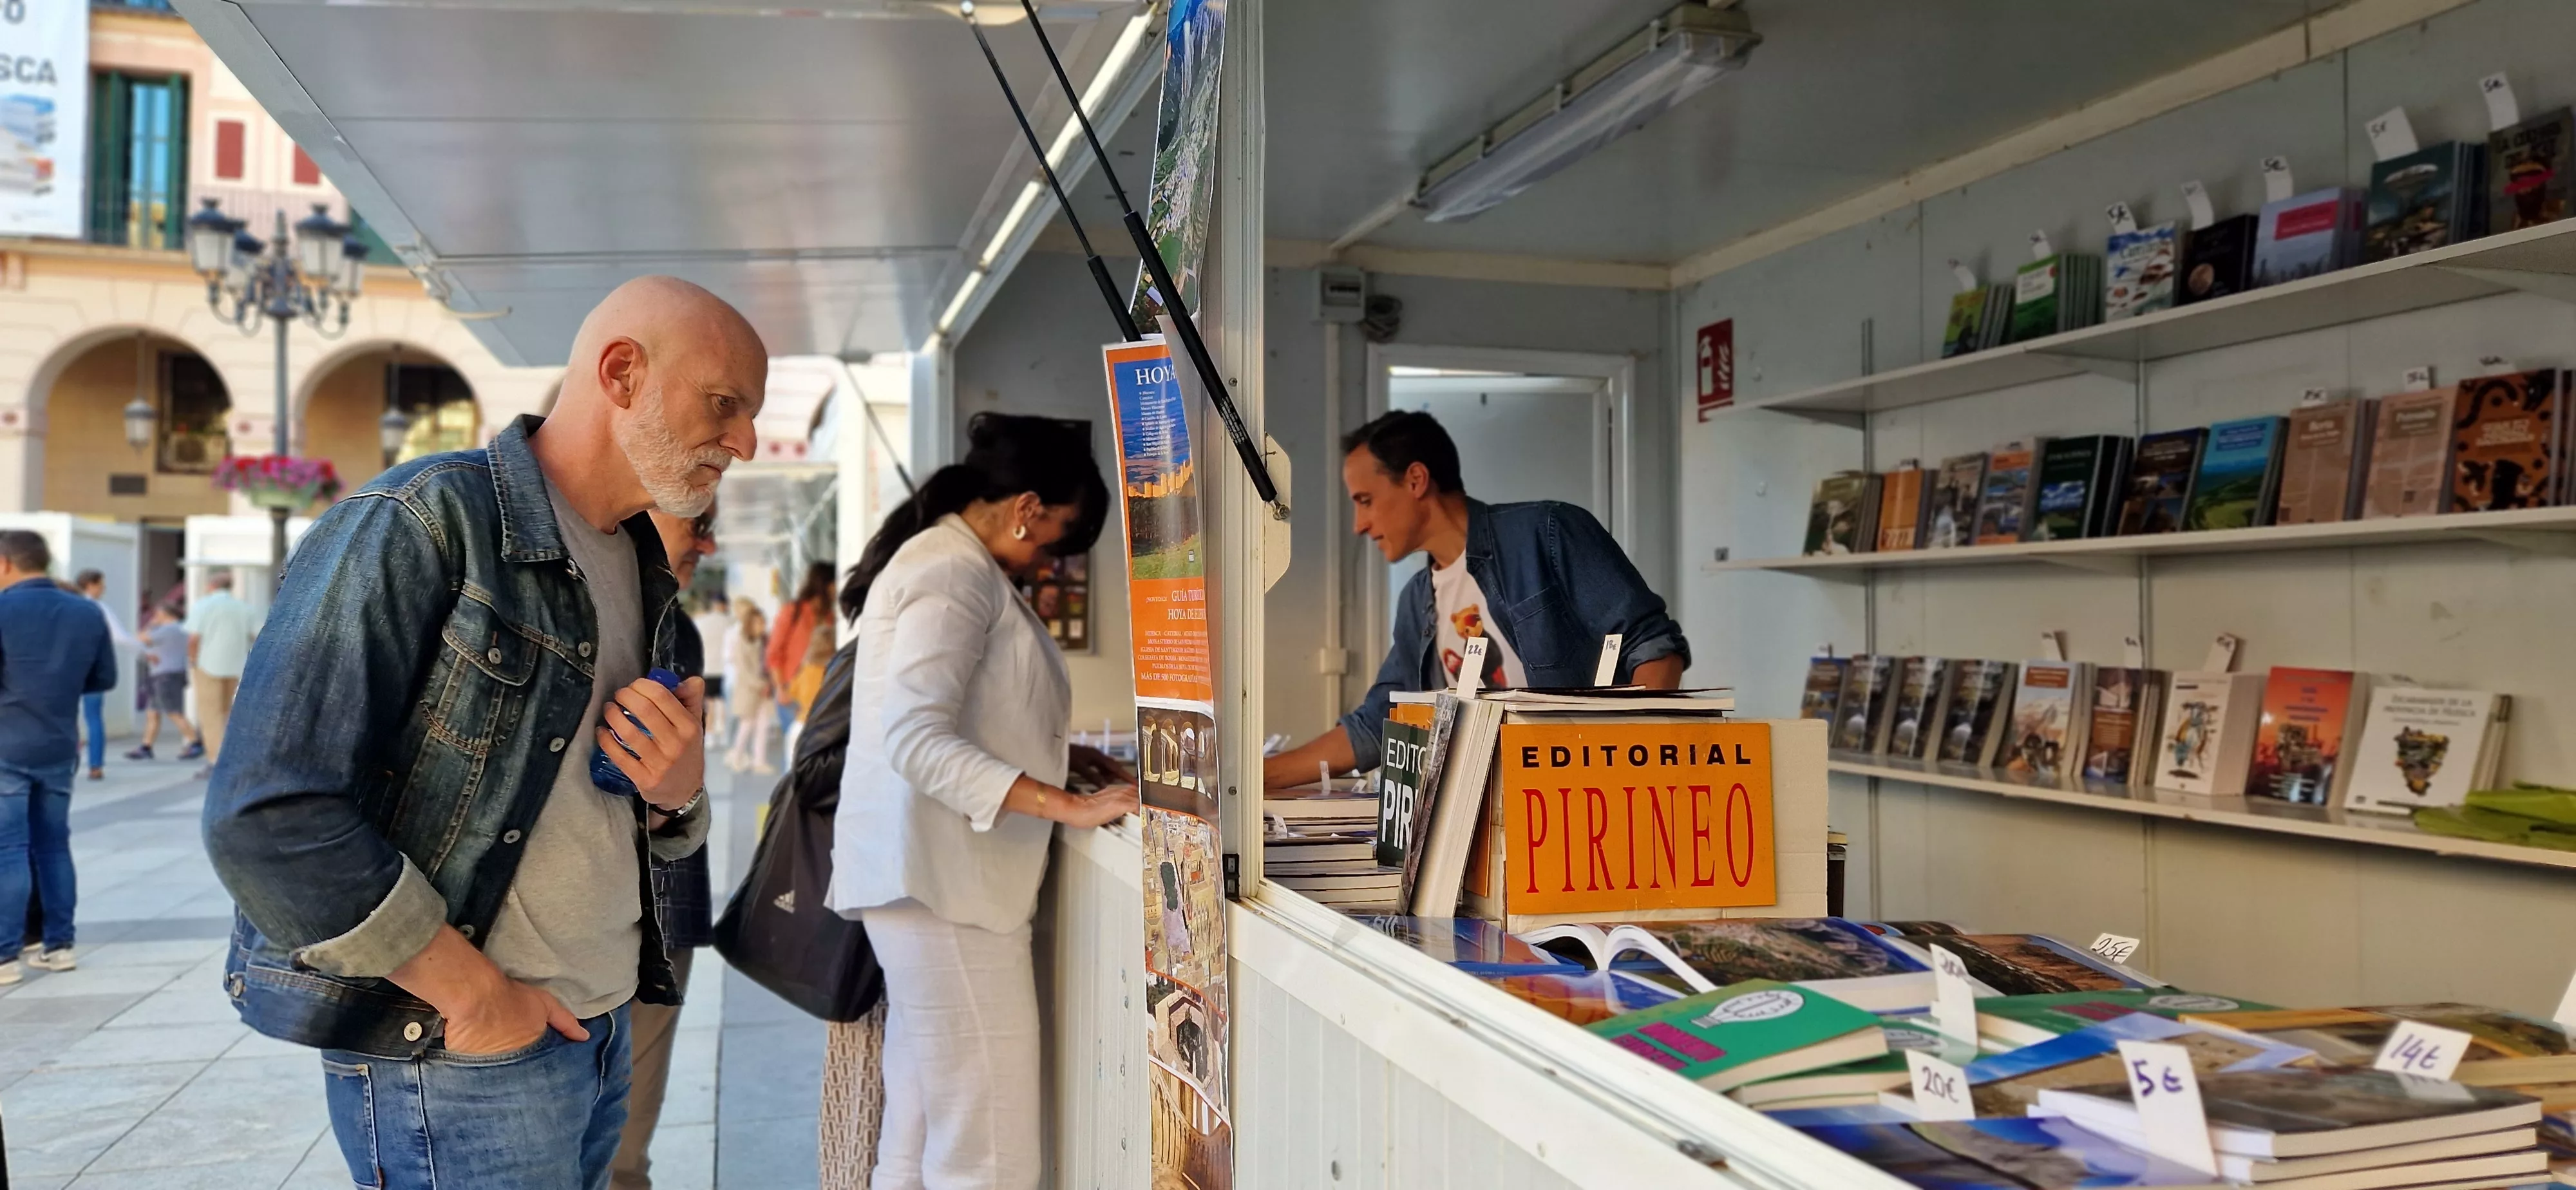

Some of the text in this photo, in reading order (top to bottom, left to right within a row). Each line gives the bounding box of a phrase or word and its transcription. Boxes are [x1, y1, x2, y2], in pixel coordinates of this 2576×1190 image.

[1171, 588, 1188, 601] GUÍA
[1168, 609, 1186, 620] HOYA
[1188, 609, 1195, 619] DE
[1141, 672, 1152, 680] MÁS
[1522, 743, 1752, 768] EDITORIAL
[1382, 779, 1419, 850] PIR
[1522, 782, 1754, 894] PIRINEO
[2092, 938, 2132, 961] 25€
[1922, 1065, 1959, 1104] 20€
